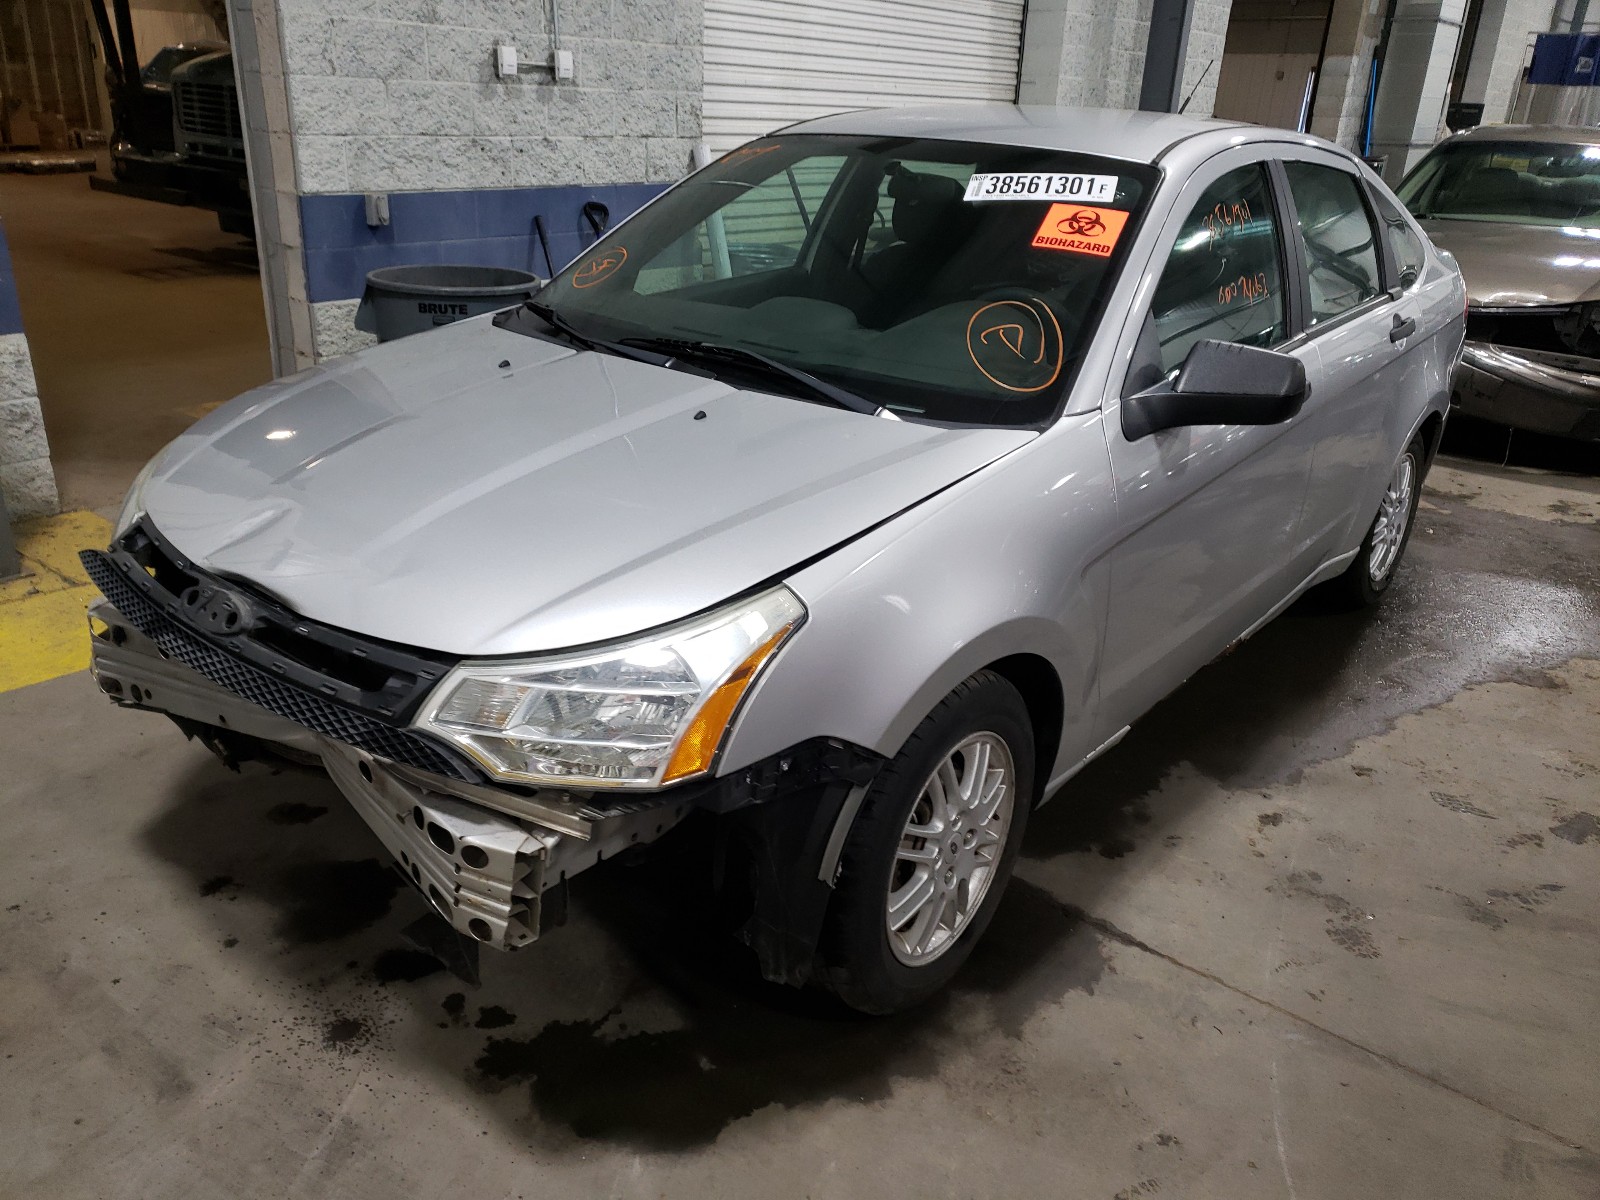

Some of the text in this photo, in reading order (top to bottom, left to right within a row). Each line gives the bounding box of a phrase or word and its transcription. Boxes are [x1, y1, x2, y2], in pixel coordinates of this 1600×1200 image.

[985, 175, 1095, 195] 38561301
[1099, 184, 1108, 194] F
[1035, 236, 1111, 254] BIOHAZARD
[418, 302, 468, 315] BRUTE
